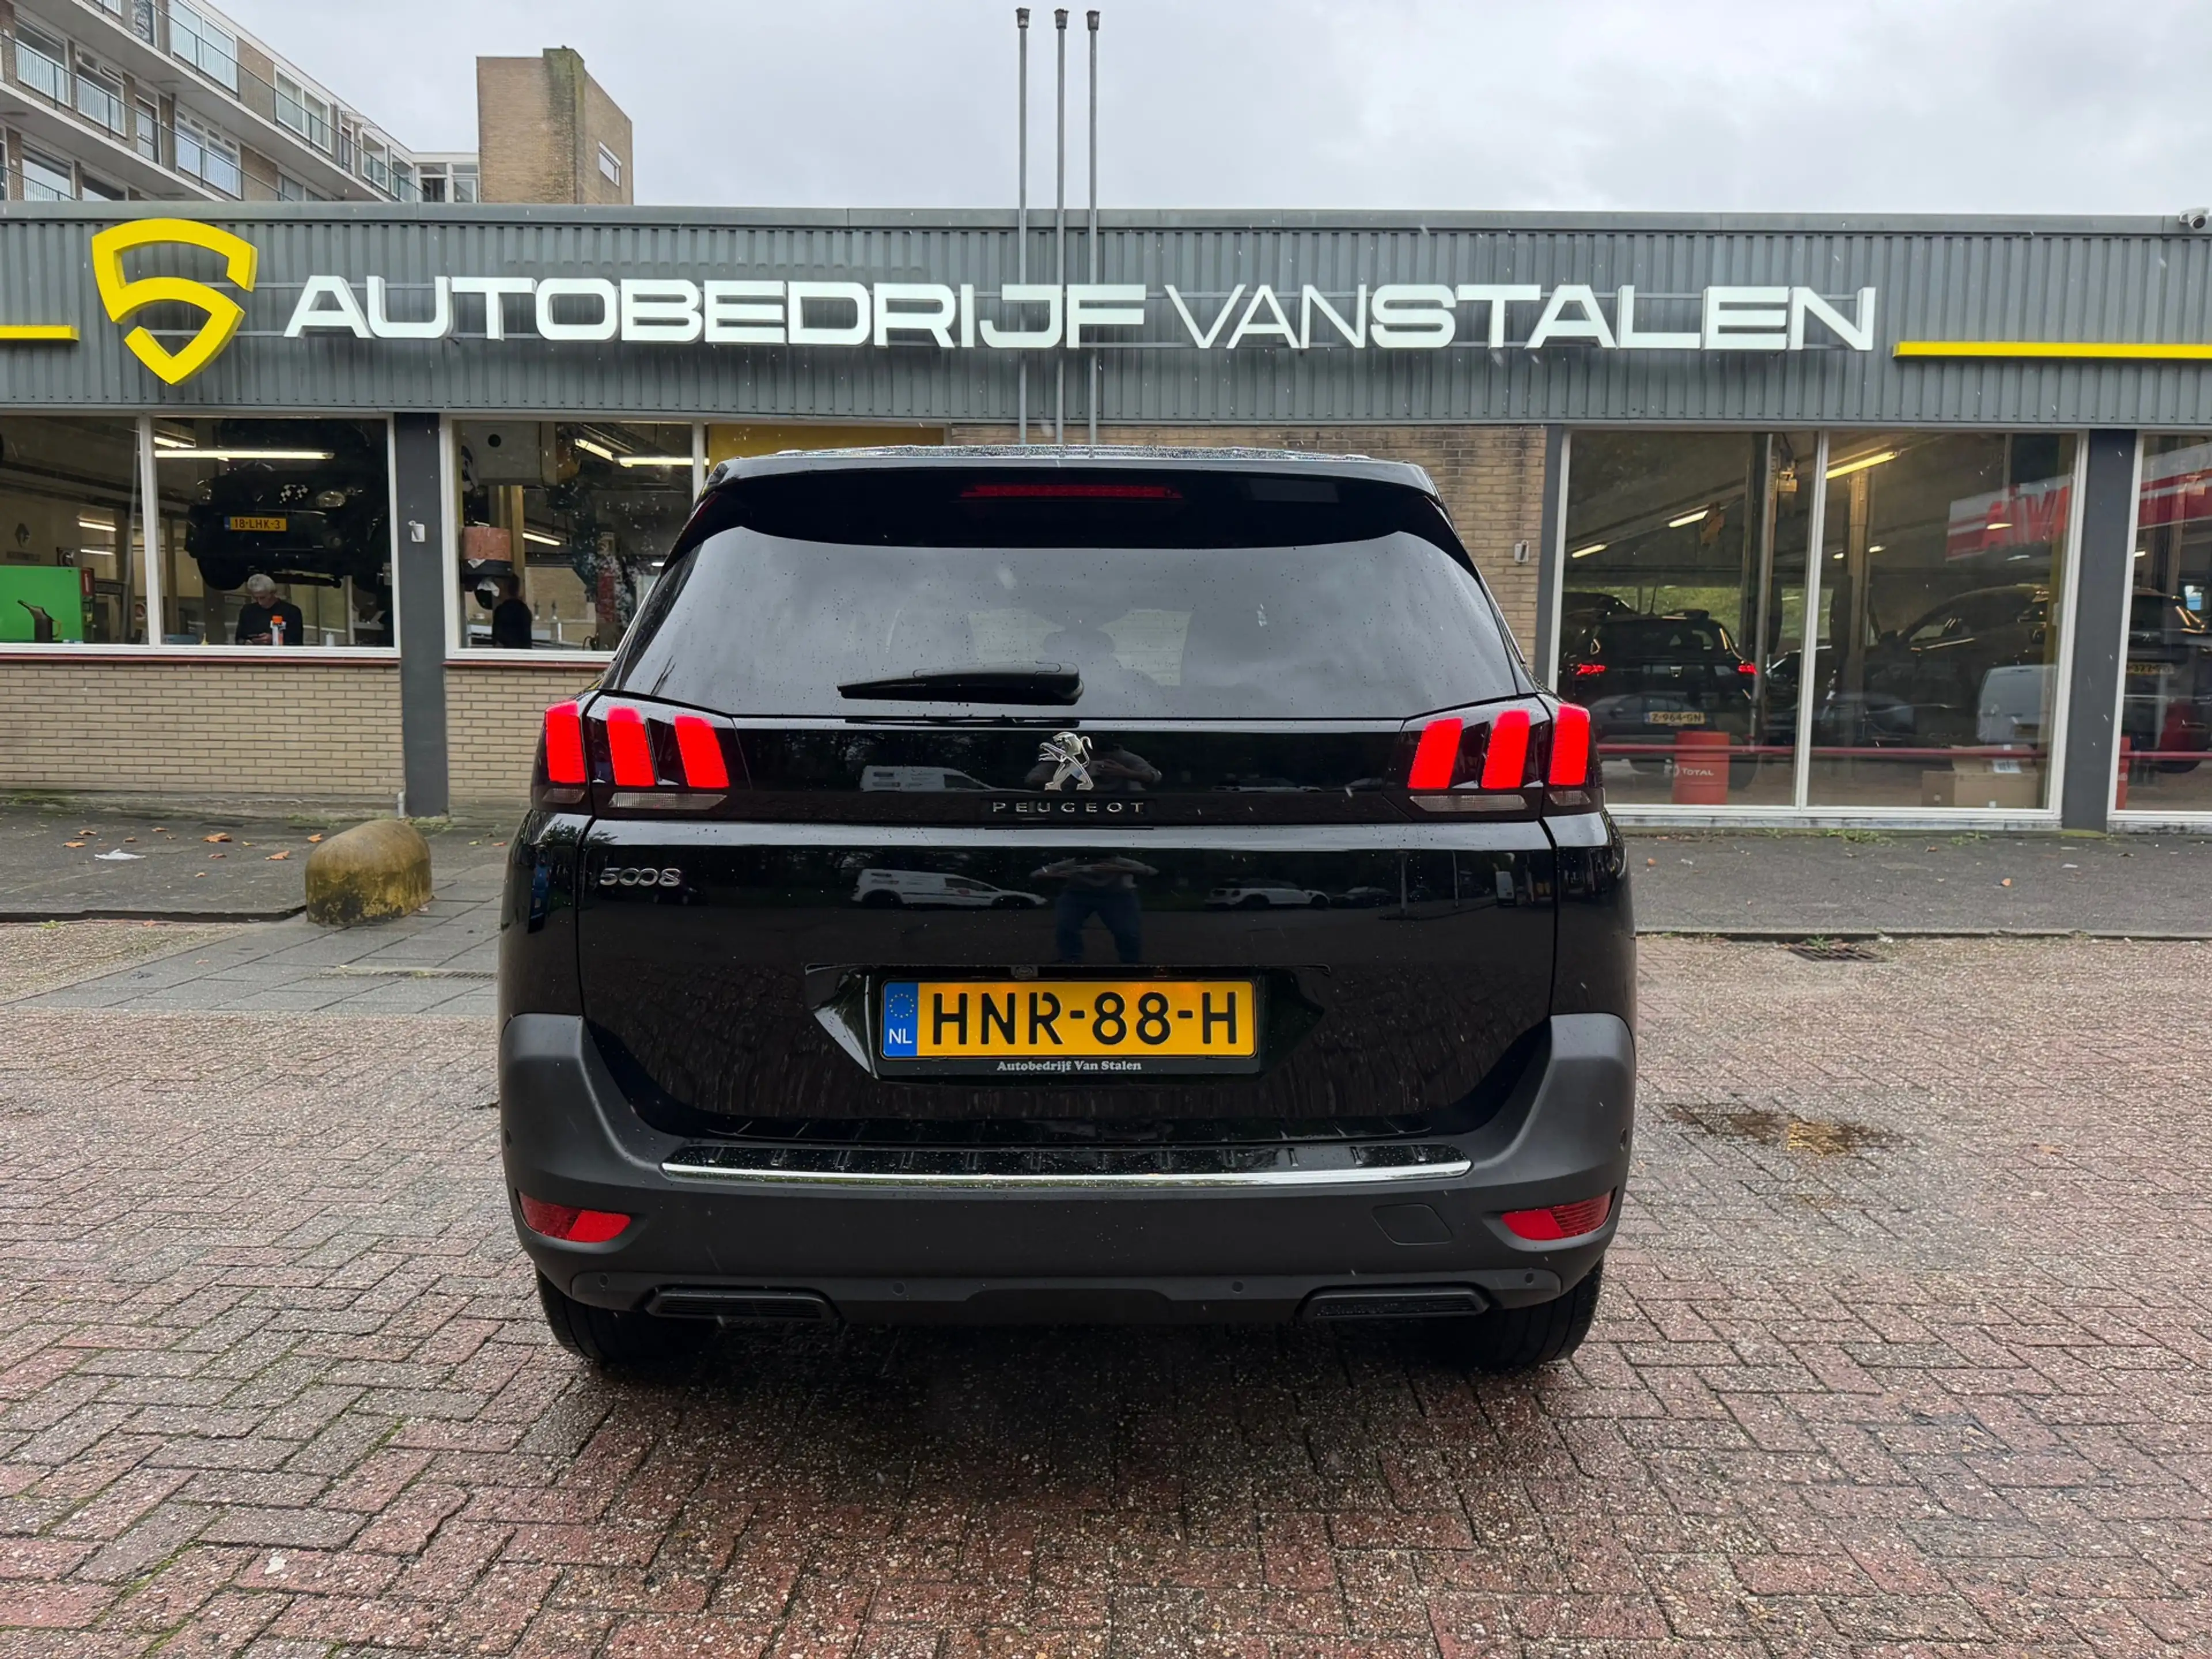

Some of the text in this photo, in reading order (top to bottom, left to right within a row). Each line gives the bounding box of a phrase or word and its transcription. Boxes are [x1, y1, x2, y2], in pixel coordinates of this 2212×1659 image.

[283, 275, 1146, 349] AUTOBEDRIJF
[234, 518, 281, 529] 18-LHK-3
[1682, 767, 1714, 776] TOTAL
[993, 801, 1144, 813] PEUGEOT
[600, 867, 681, 887] 5008
[932, 991, 1237, 1046] HNR-88-H
[889, 1028, 912, 1044] NL
[997, 1060, 1142, 1073] Autobedrijf Van Stalen
